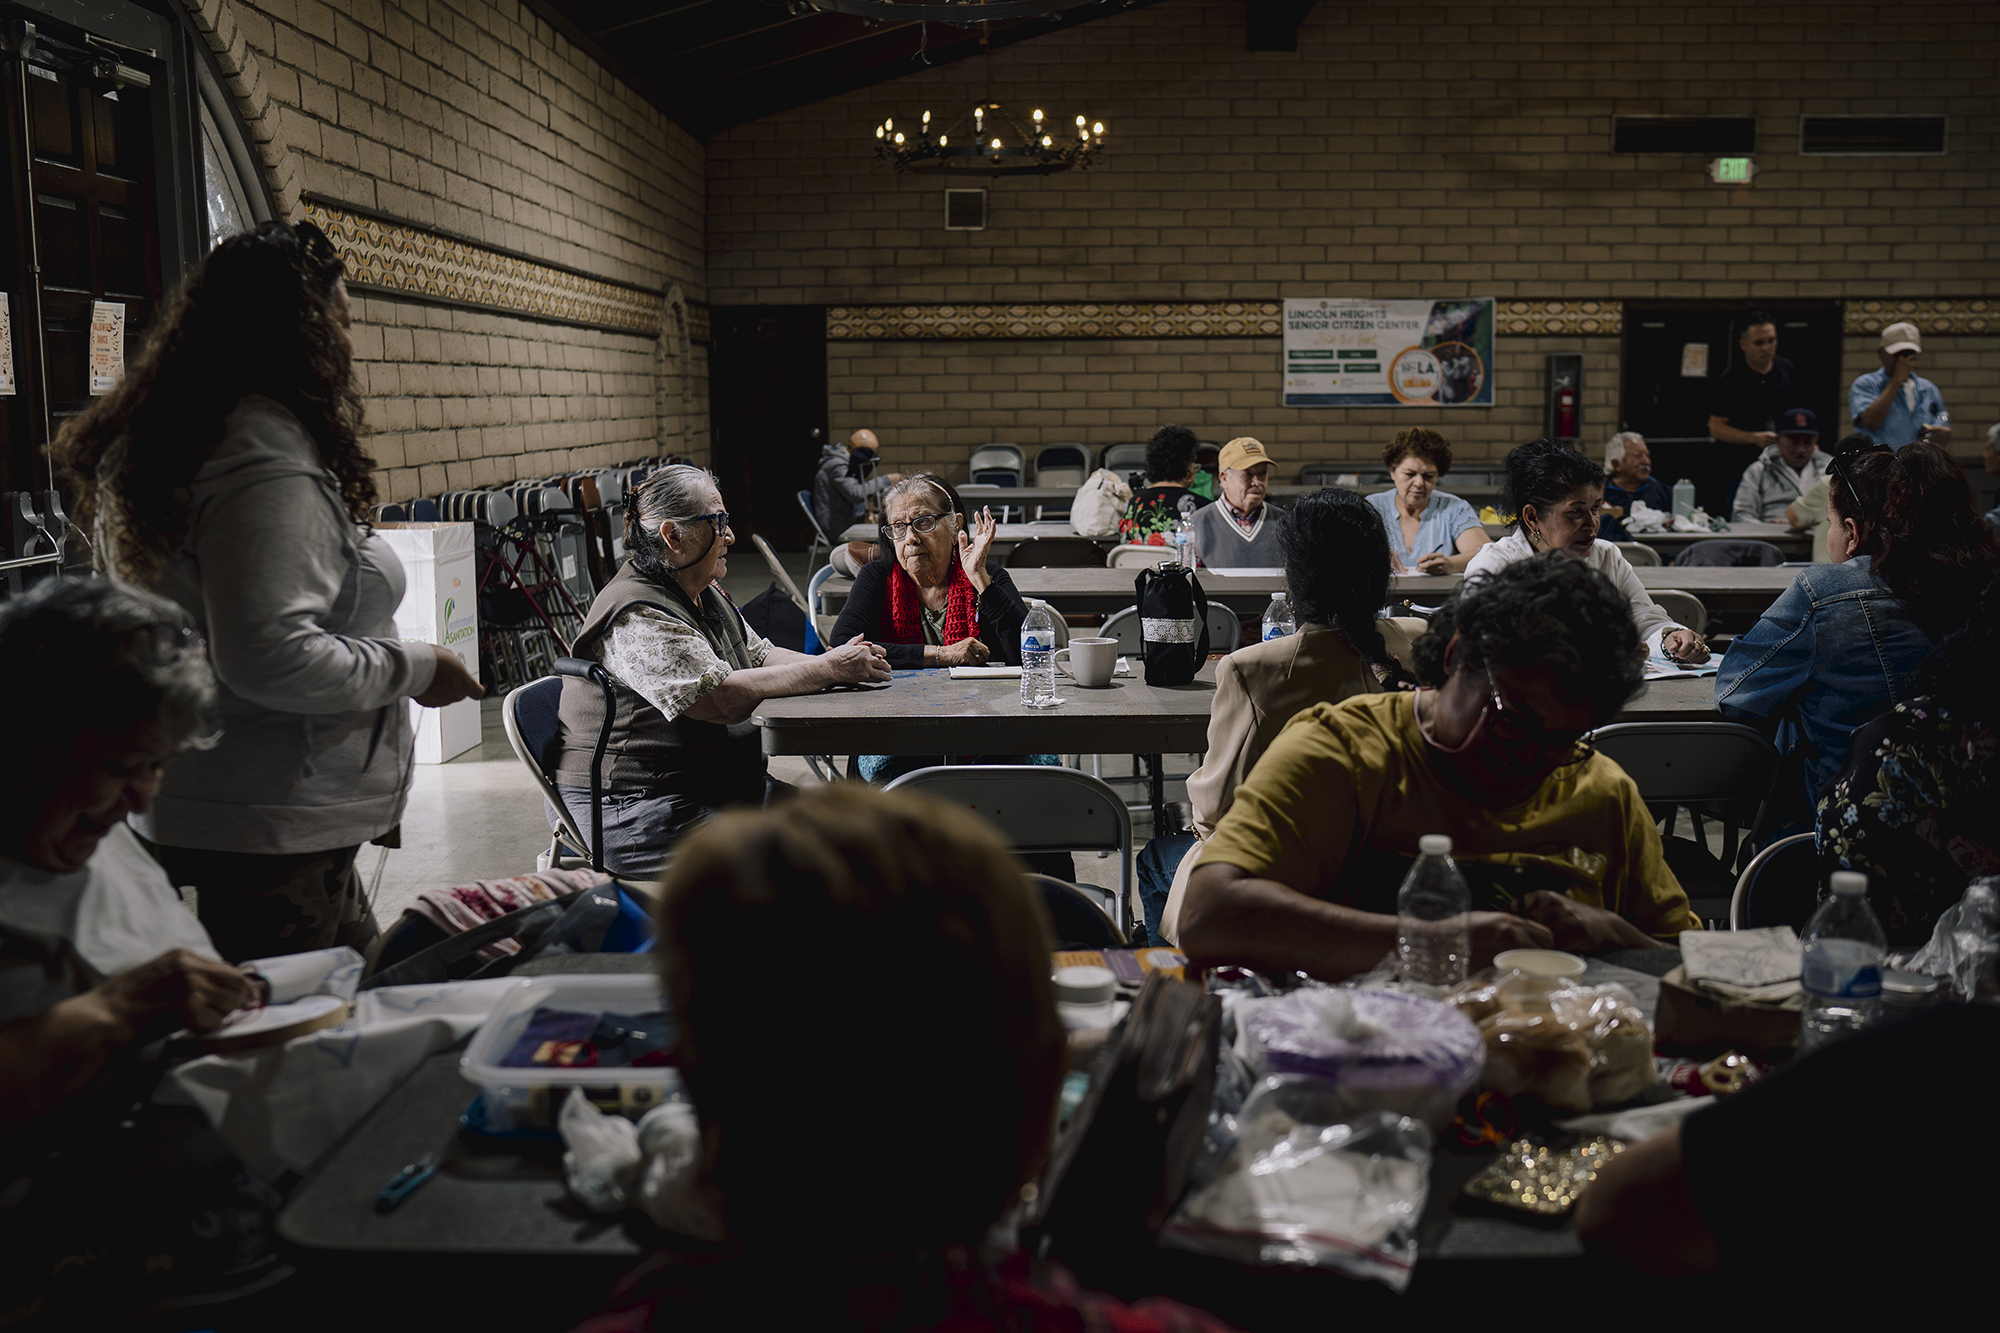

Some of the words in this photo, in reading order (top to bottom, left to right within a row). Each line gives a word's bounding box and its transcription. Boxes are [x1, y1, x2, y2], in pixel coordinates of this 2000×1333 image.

[1720, 157, 1748, 180] EXIT
[1288, 310, 1337, 319] LINCOLN
[1340, 310, 1387, 319] HEIGHTS
[1288, 321, 1328, 330] SENIOR
[1332, 321, 1374, 330] CITIZEN
[1377, 321, 1419, 330] CENTER
[1418, 361, 1435, 374] LA
